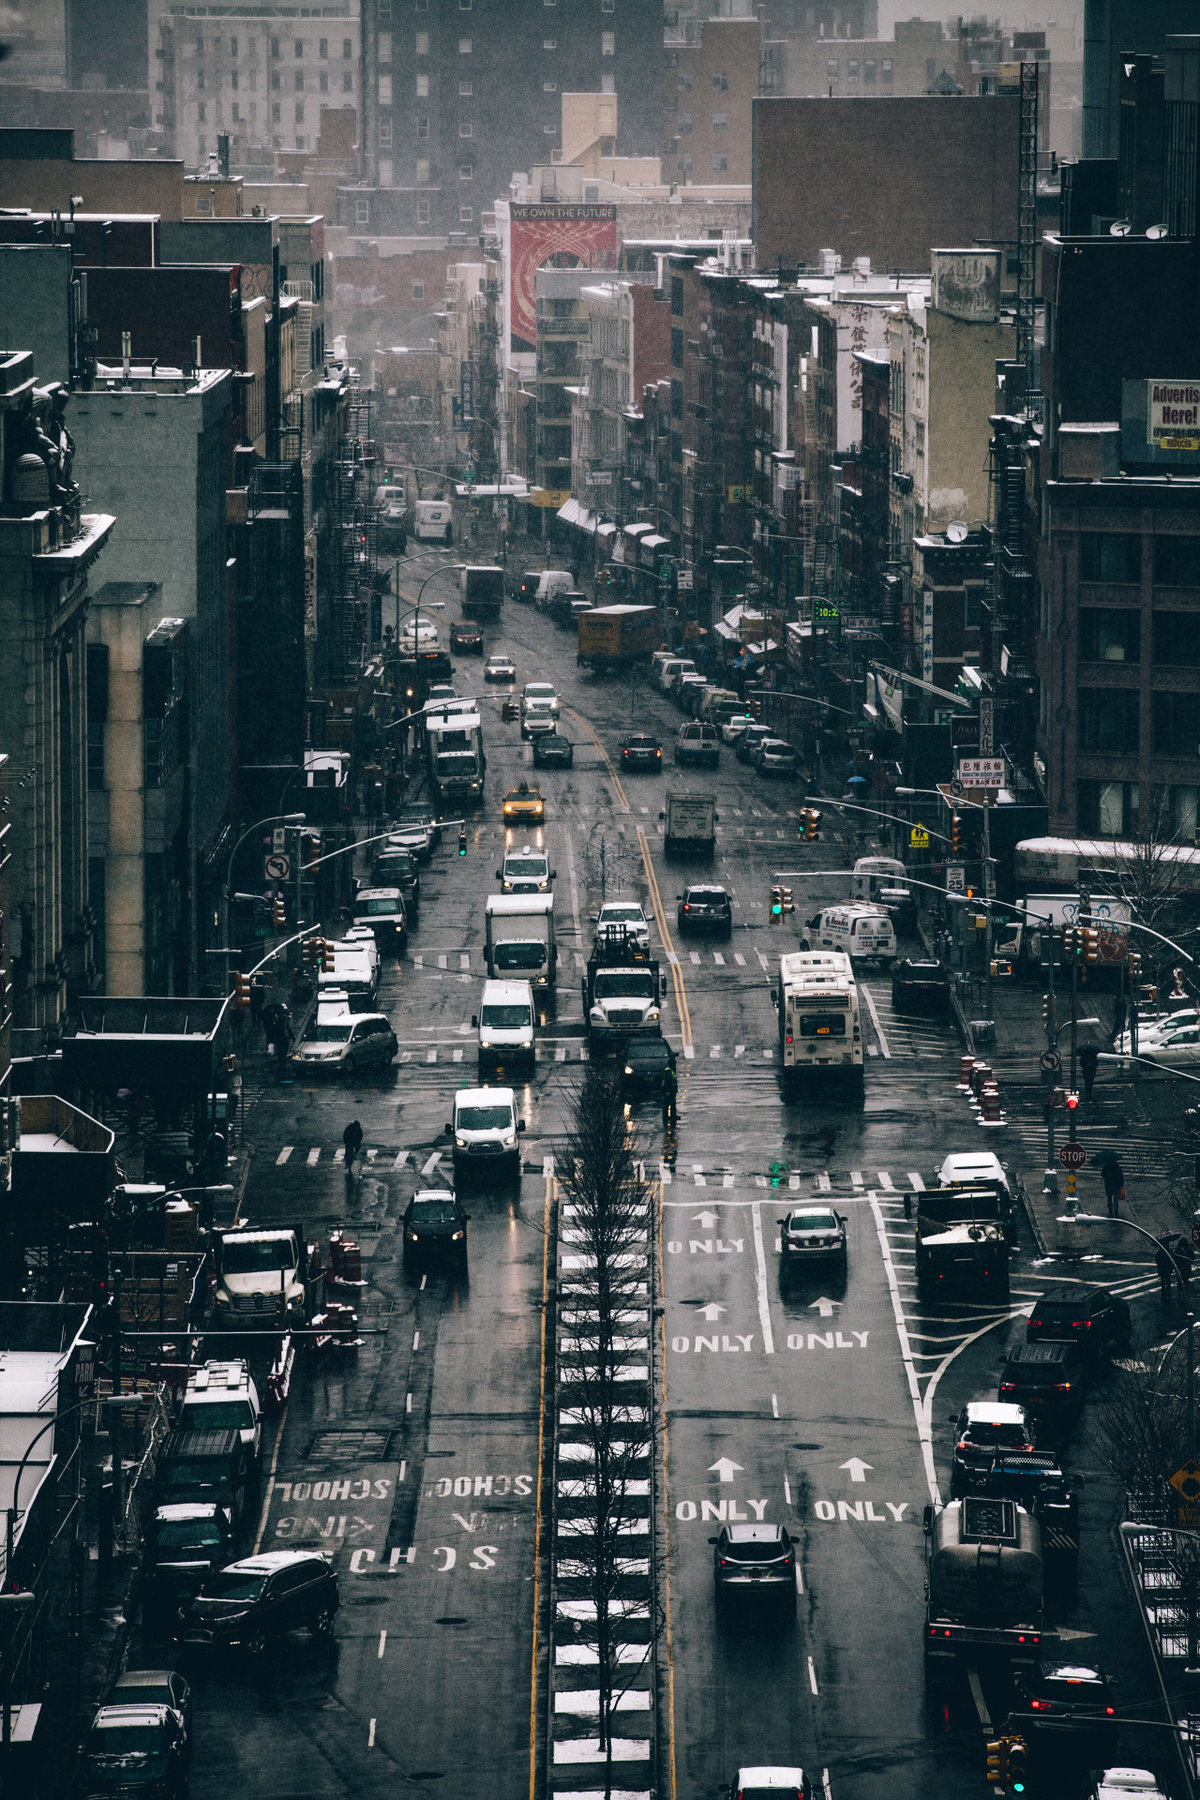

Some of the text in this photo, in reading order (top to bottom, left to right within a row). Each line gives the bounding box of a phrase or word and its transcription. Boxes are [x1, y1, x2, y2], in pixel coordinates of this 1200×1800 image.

[512, 208, 613, 217] WE OWN THE FUTURE
[1153, 386, 1200, 402] Advertis
[1162, 406, 1198, 424] Here!
[1166, 440, 1192, 448] REDUCED
[819, 608, 839, 617] 10:2
[923, 604, 933, 684] 第一牙科中
[948, 880, 963, 890] 25
[1061, 1151, 1085, 1159] STOP
[667, 1238, 744, 1254] ONLY
[672, 1334, 754, 1353] ONLY
[787, 1330, 870, 1350] ONLY
[75, 1362, 95, 1383] PARK
[275, 1479, 391, 1502] SCHOOL
[425, 1475, 533, 1497] SCHOO
[675, 1499, 768, 1521] ONLY
[814, 1500, 909, 1521] ONLY
